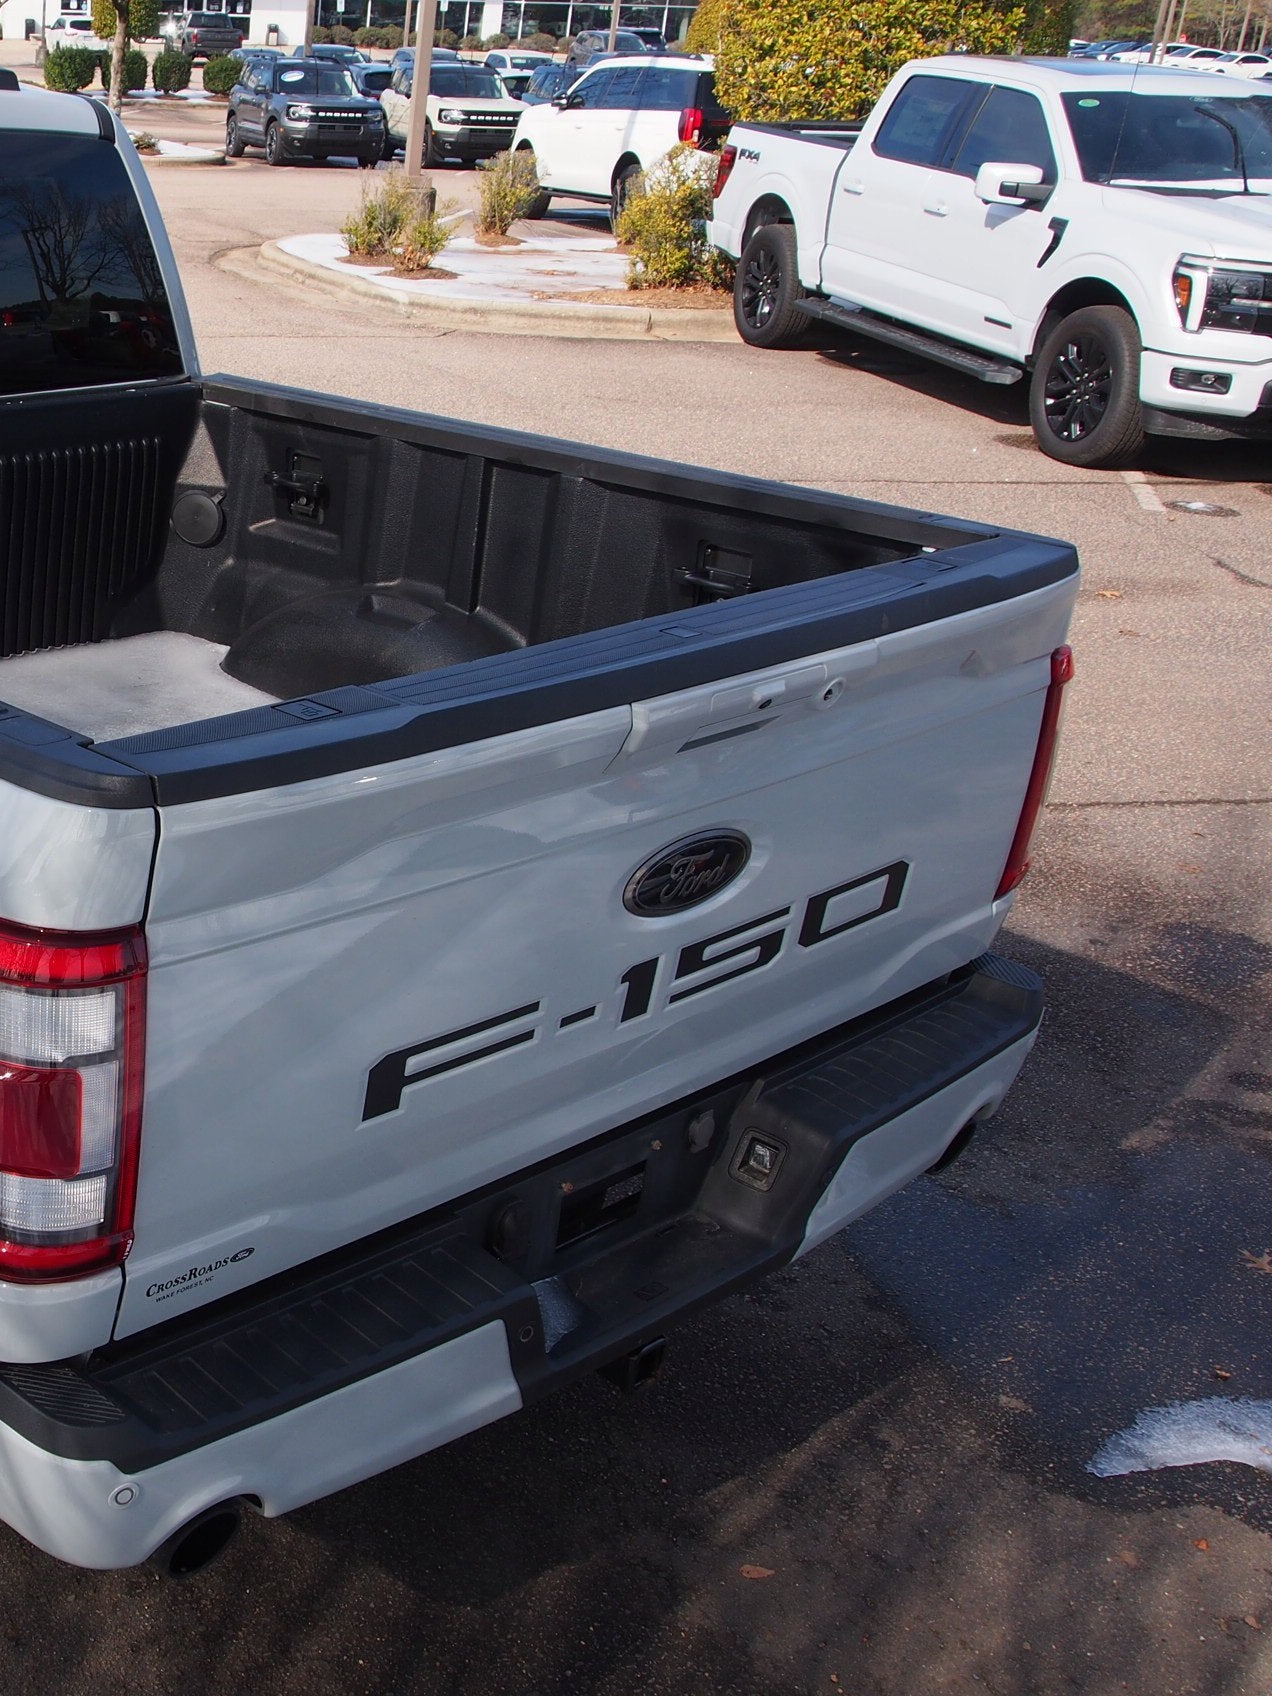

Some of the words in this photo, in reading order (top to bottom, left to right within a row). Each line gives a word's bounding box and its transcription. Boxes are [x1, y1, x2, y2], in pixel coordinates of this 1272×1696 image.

[738, 148, 762, 162] FX4
[659, 849, 730, 901] Ford
[361, 860, 910, 1123] F-150
[155, 1291, 175, 1302] WAKE
[176, 1280, 204, 1294] FOREST,
[204, 1275, 216, 1284] NC
